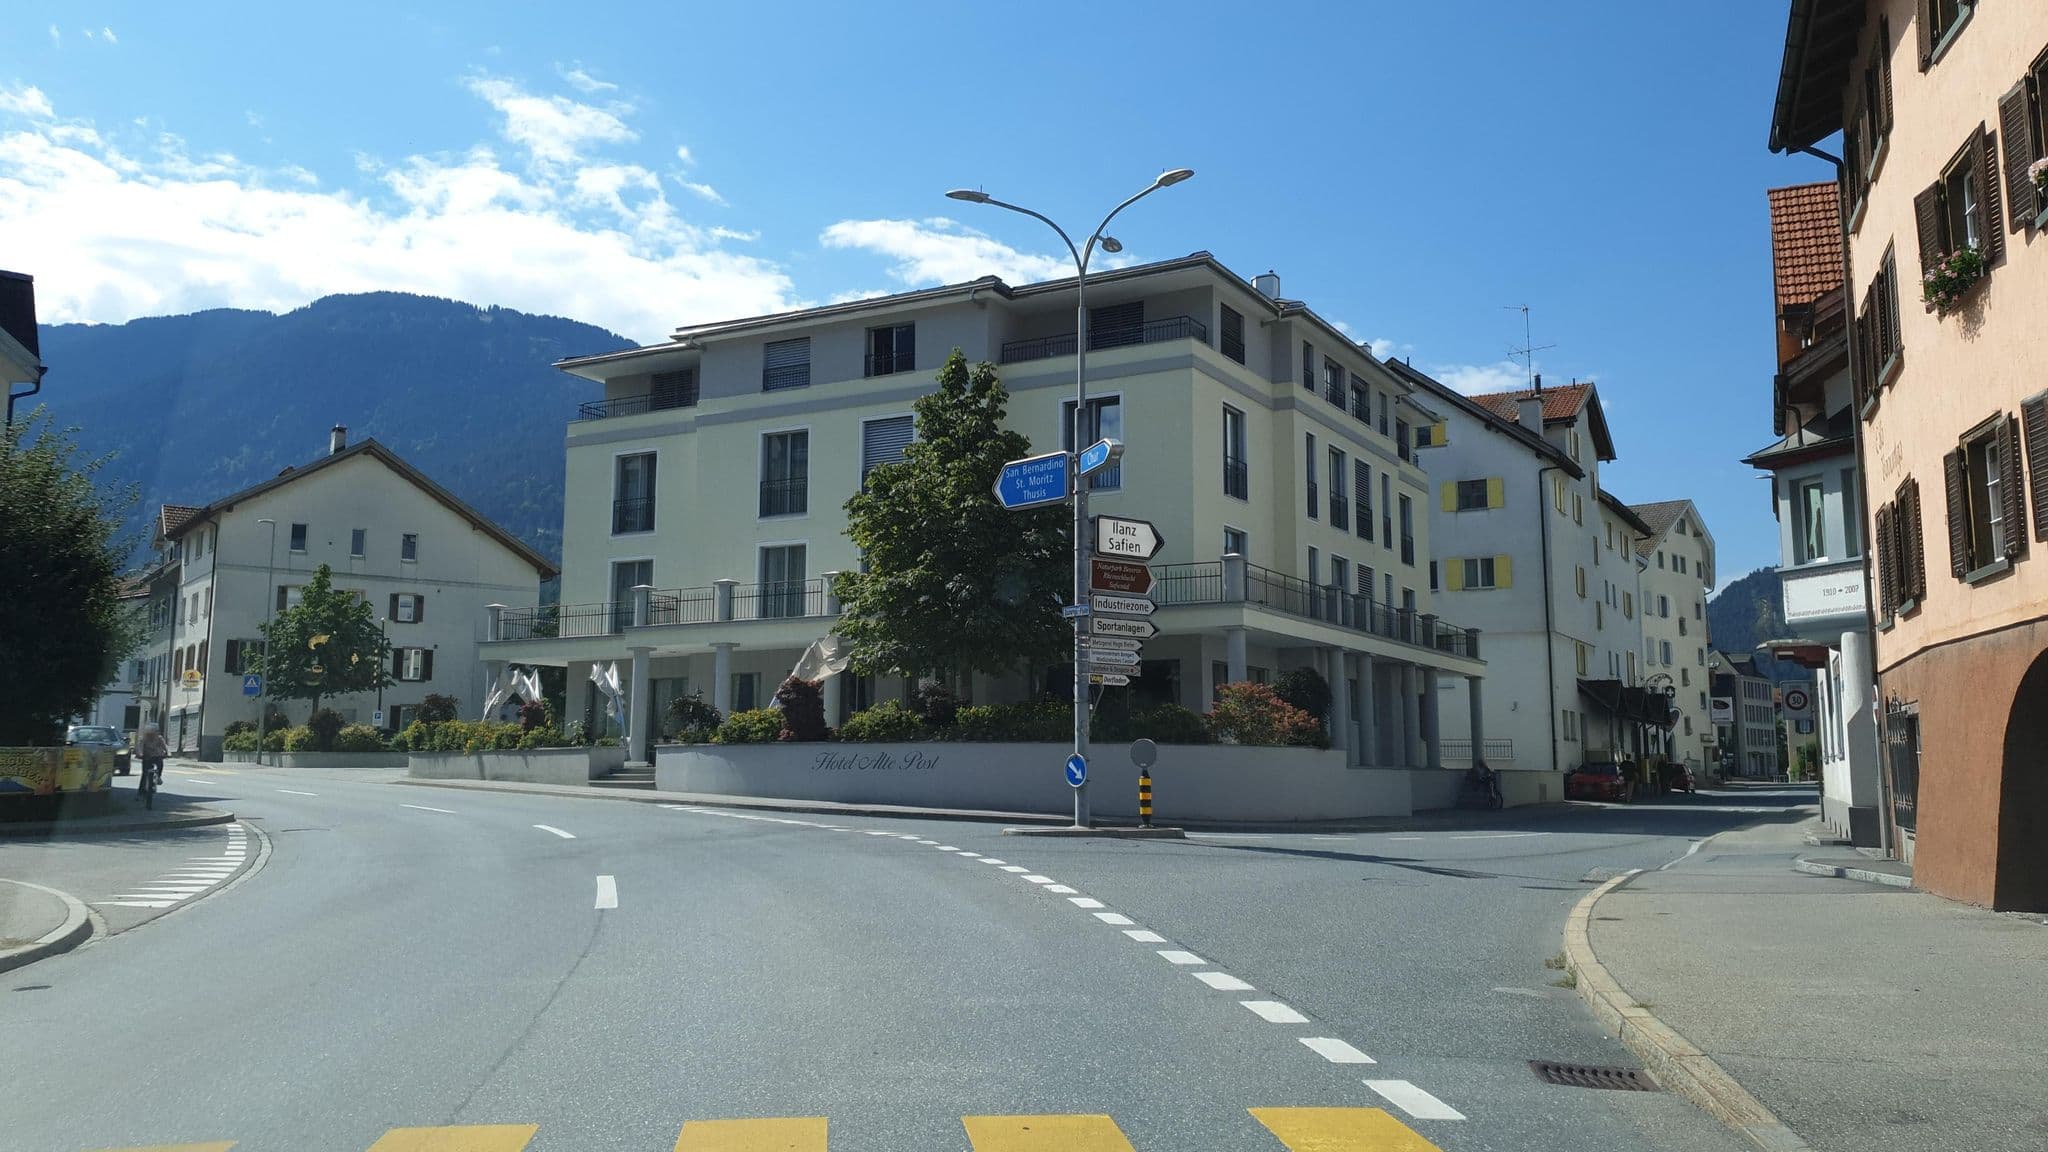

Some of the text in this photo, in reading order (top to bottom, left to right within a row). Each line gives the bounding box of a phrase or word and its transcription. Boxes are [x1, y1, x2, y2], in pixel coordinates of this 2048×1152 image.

[1005, 458, 1064, 479] San Bernardino
[1016, 474, 1054, 489] St. Moritz
[1023, 486, 1047, 501] Thusis
[1112, 521, 1137, 537] Ilanz
[1108, 537, 1141, 553] Safien
[1095, 598, 1149, 612] Industriezone
[1097, 620, 1146, 635] Sportanlagen
[811, 750, 940, 770] Hotel Alte Post
